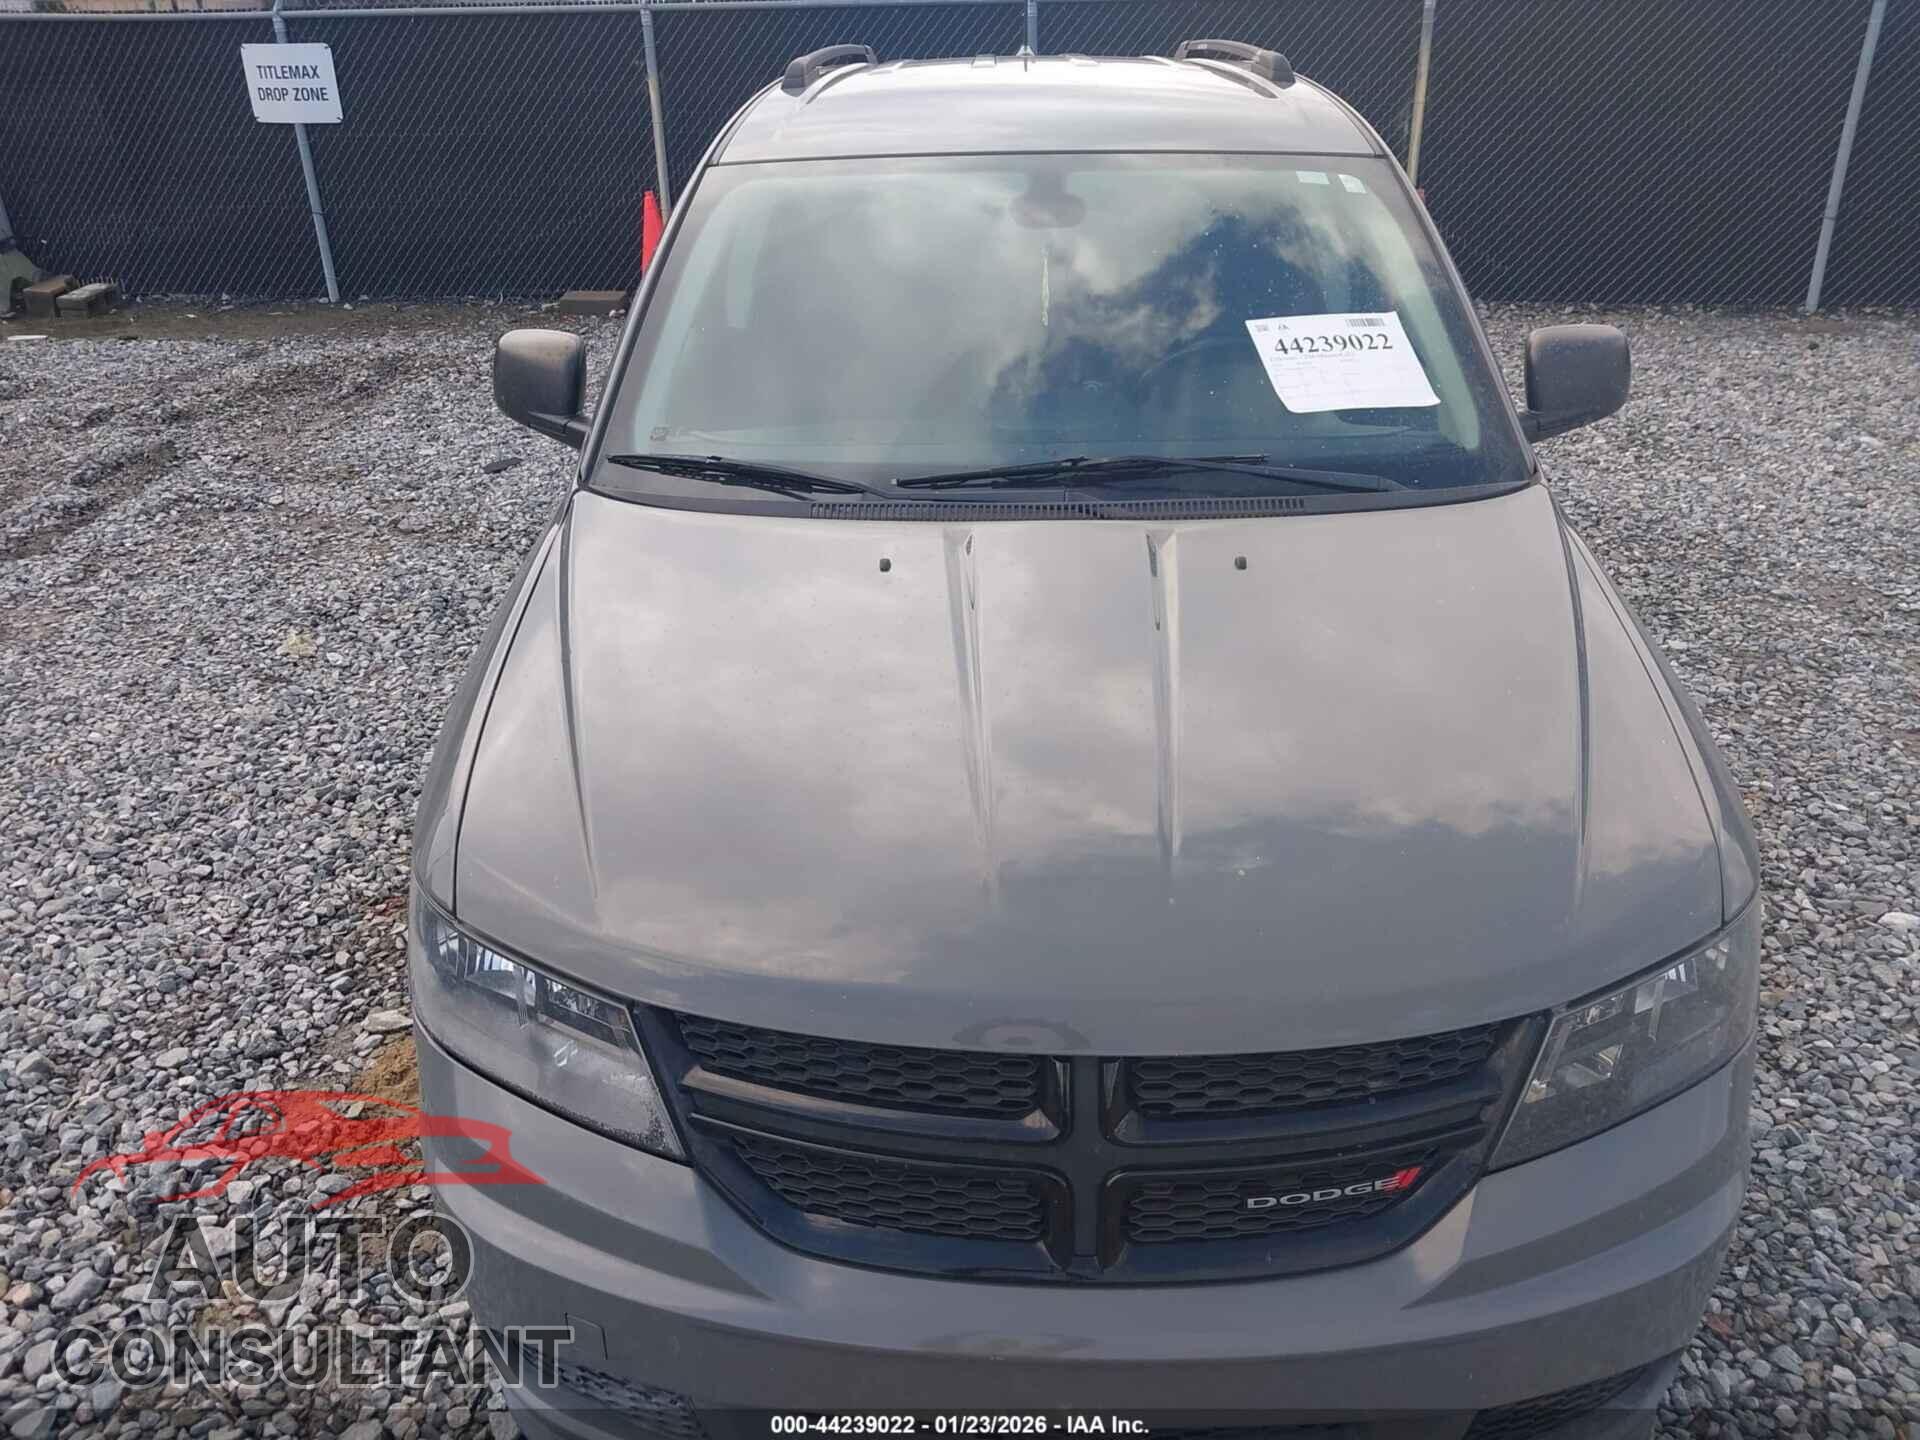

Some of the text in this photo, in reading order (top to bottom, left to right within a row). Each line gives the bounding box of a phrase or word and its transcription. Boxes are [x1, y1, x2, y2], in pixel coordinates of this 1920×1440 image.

[256, 65, 320, 79] TITLEMAX
[257, 87, 329, 101] DROP ZONE
[1275, 333, 1393, 354] 44239022
[1247, 1175, 1401, 1209] DODGE
